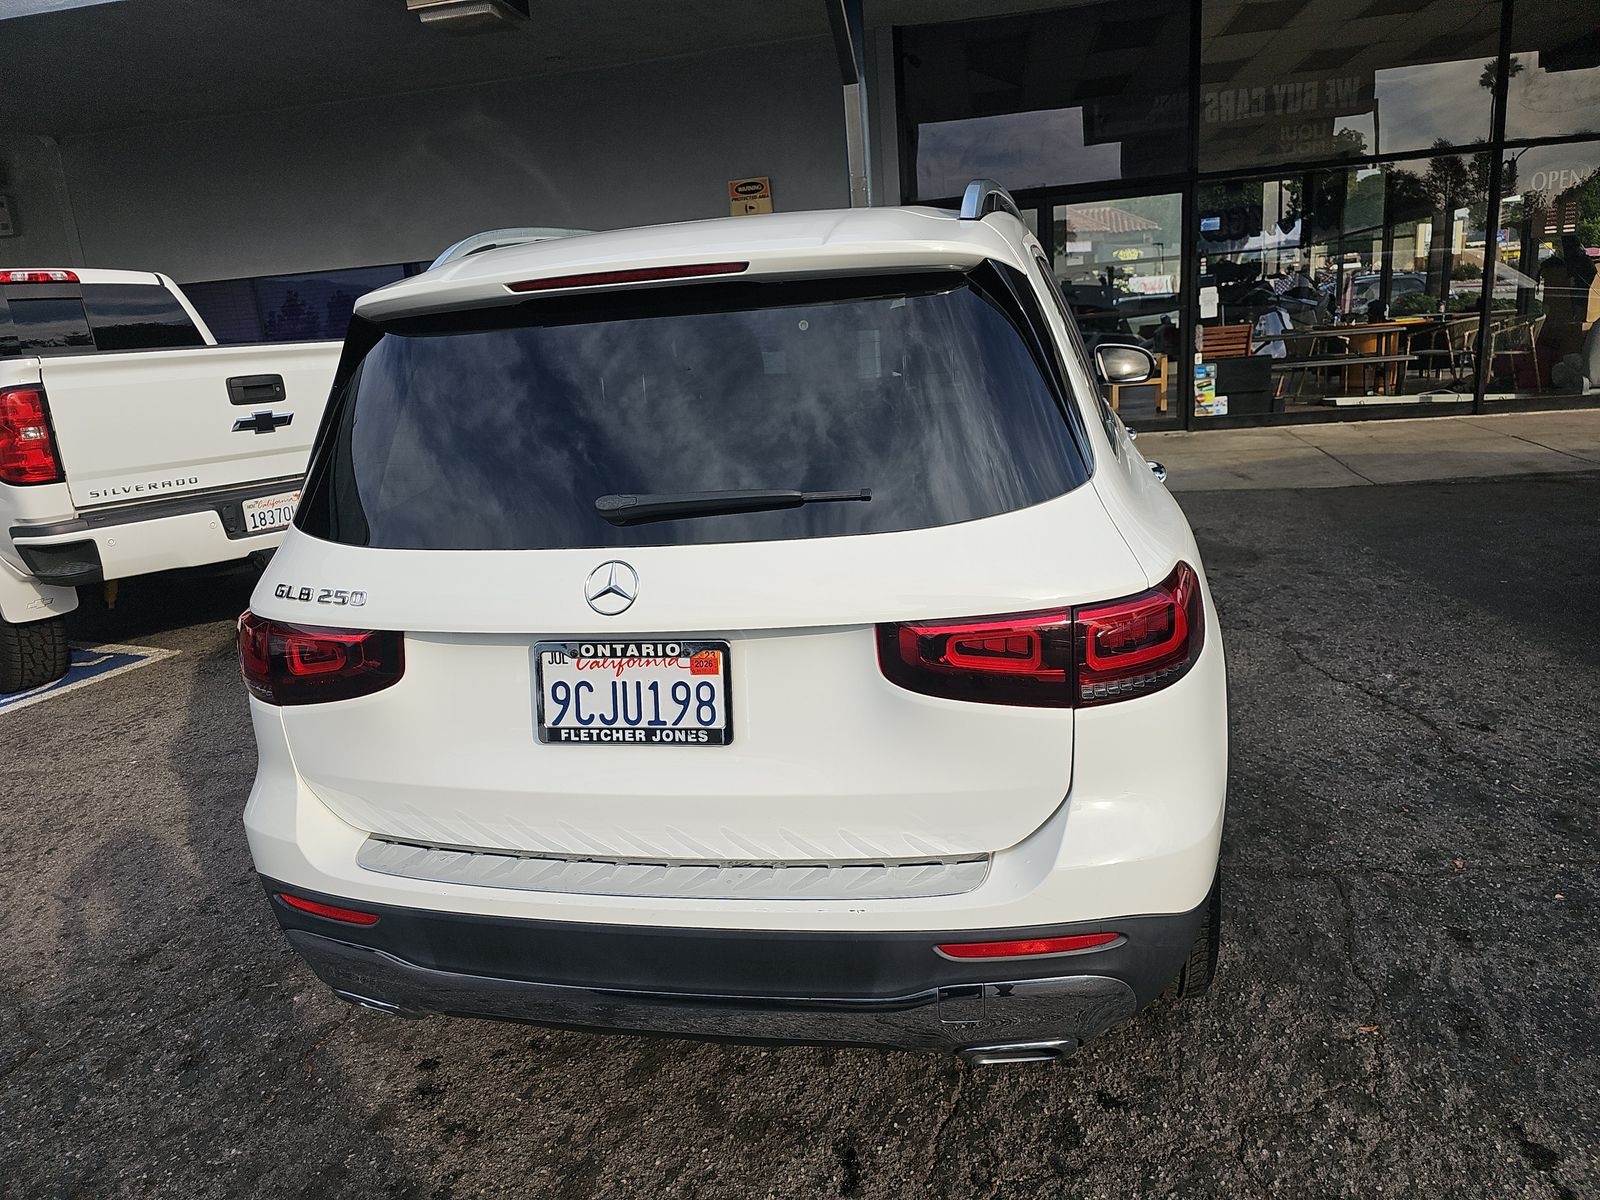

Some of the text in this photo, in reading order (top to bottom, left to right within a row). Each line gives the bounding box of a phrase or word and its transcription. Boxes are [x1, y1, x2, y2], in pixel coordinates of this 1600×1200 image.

[1531, 168, 1585, 191] OPEN
[737, 184, 762, 192] WARNING
[89, 477, 198, 498] SILVERADO
[257, 497, 293, 509] California
[274, 583, 314, 602] GLB
[317, 589, 368, 606] 250
[580, 643, 681, 657] ONTARIO
[548, 652, 568, 665] JUL
[694, 660, 713, 668] 2026
[576, 657, 690, 677] California
[551, 680, 716, 726] 9CJU198
[560, 729, 709, 742] FLETCHER JONES
